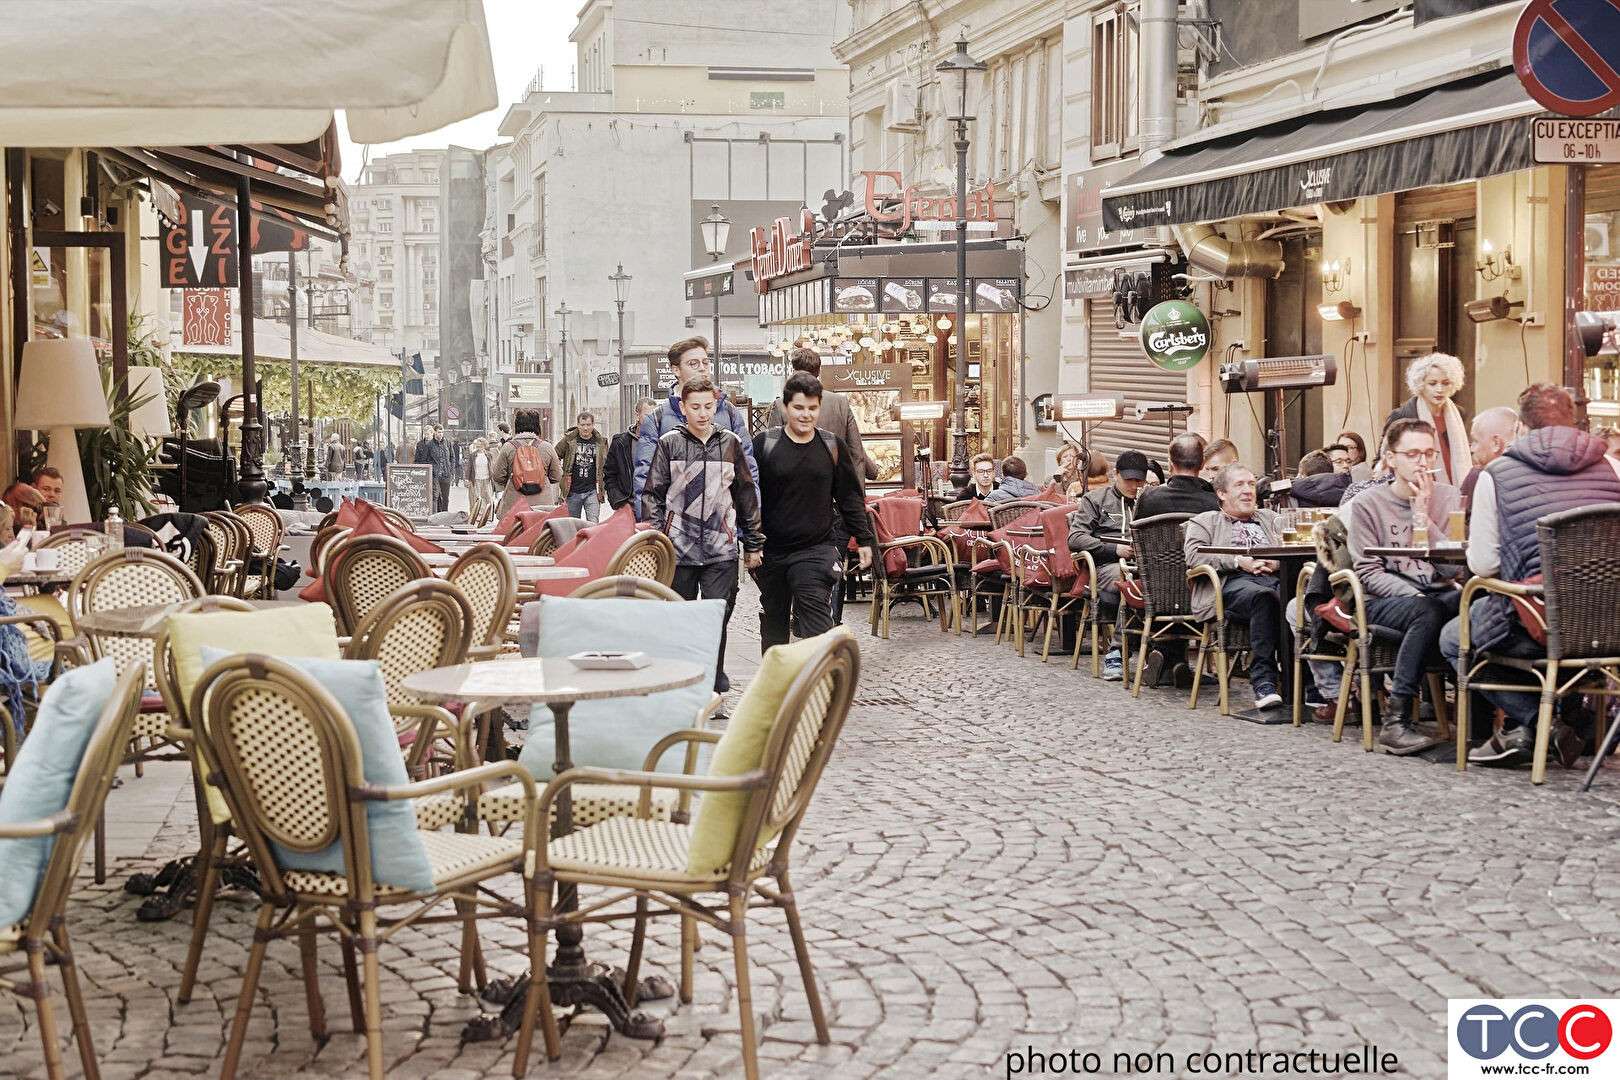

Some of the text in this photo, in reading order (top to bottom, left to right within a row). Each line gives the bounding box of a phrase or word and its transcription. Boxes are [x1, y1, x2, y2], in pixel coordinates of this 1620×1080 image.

[1537, 122, 1554, 139] CU
[1149, 327, 1206, 352] Carlsberg
[836, 368, 891, 381] XCLUSIVE
